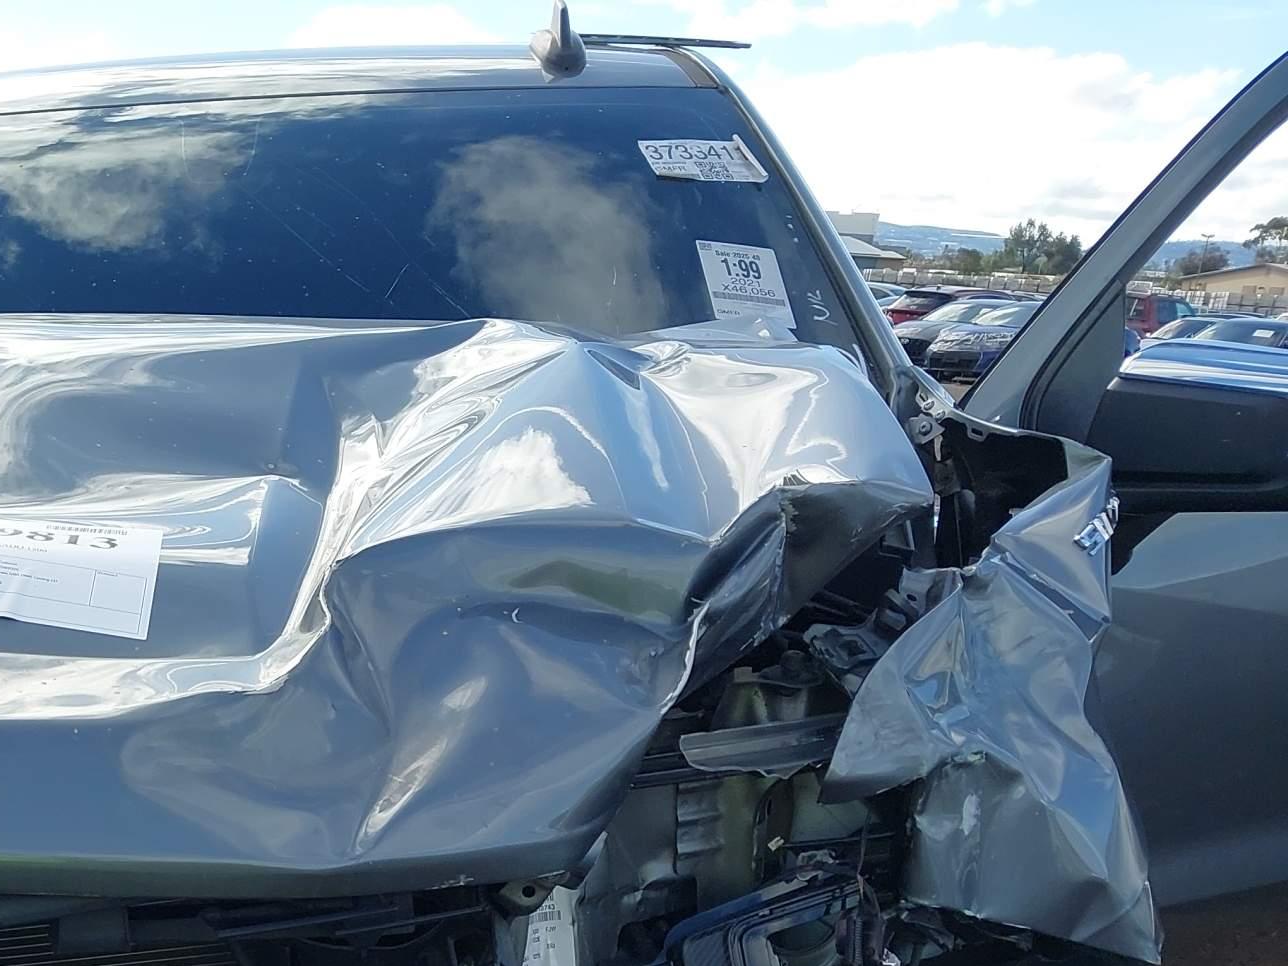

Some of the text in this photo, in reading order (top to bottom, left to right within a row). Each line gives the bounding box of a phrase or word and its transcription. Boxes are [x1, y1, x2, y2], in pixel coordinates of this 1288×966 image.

[721, 257, 762, 280] 1:99
[730, 277, 761, 287] 2021
[722, 283, 776, 298] X46,056
